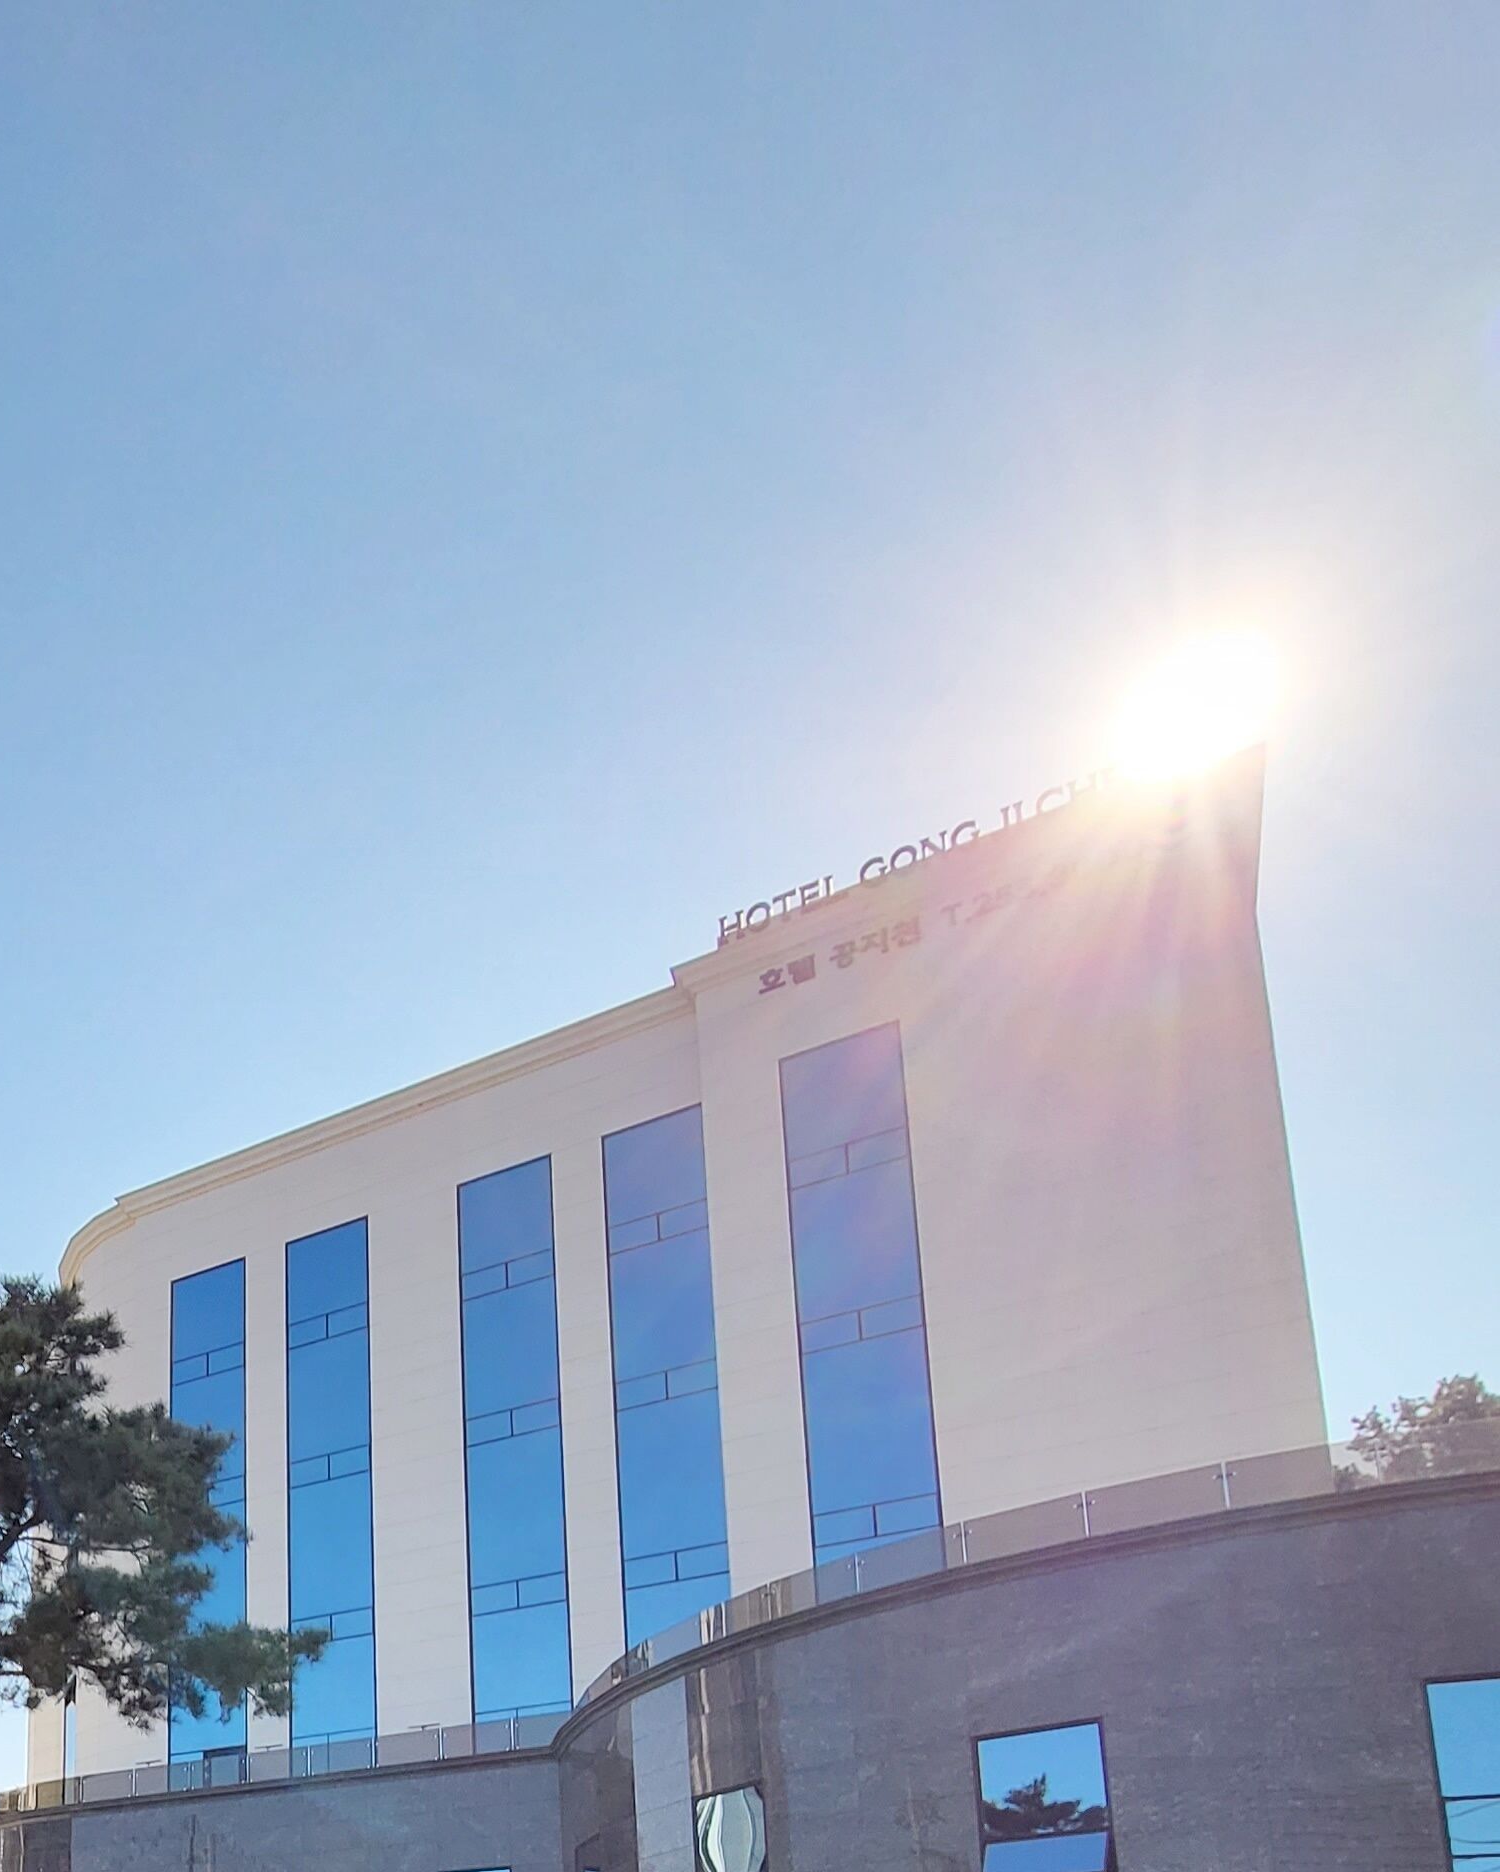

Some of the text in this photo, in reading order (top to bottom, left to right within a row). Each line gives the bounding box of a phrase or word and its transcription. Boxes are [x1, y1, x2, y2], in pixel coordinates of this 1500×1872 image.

[717, 874, 849, 950] HOTEL
[859, 819, 981, 889] GONG
[759, 954, 816, 995] 호텔
